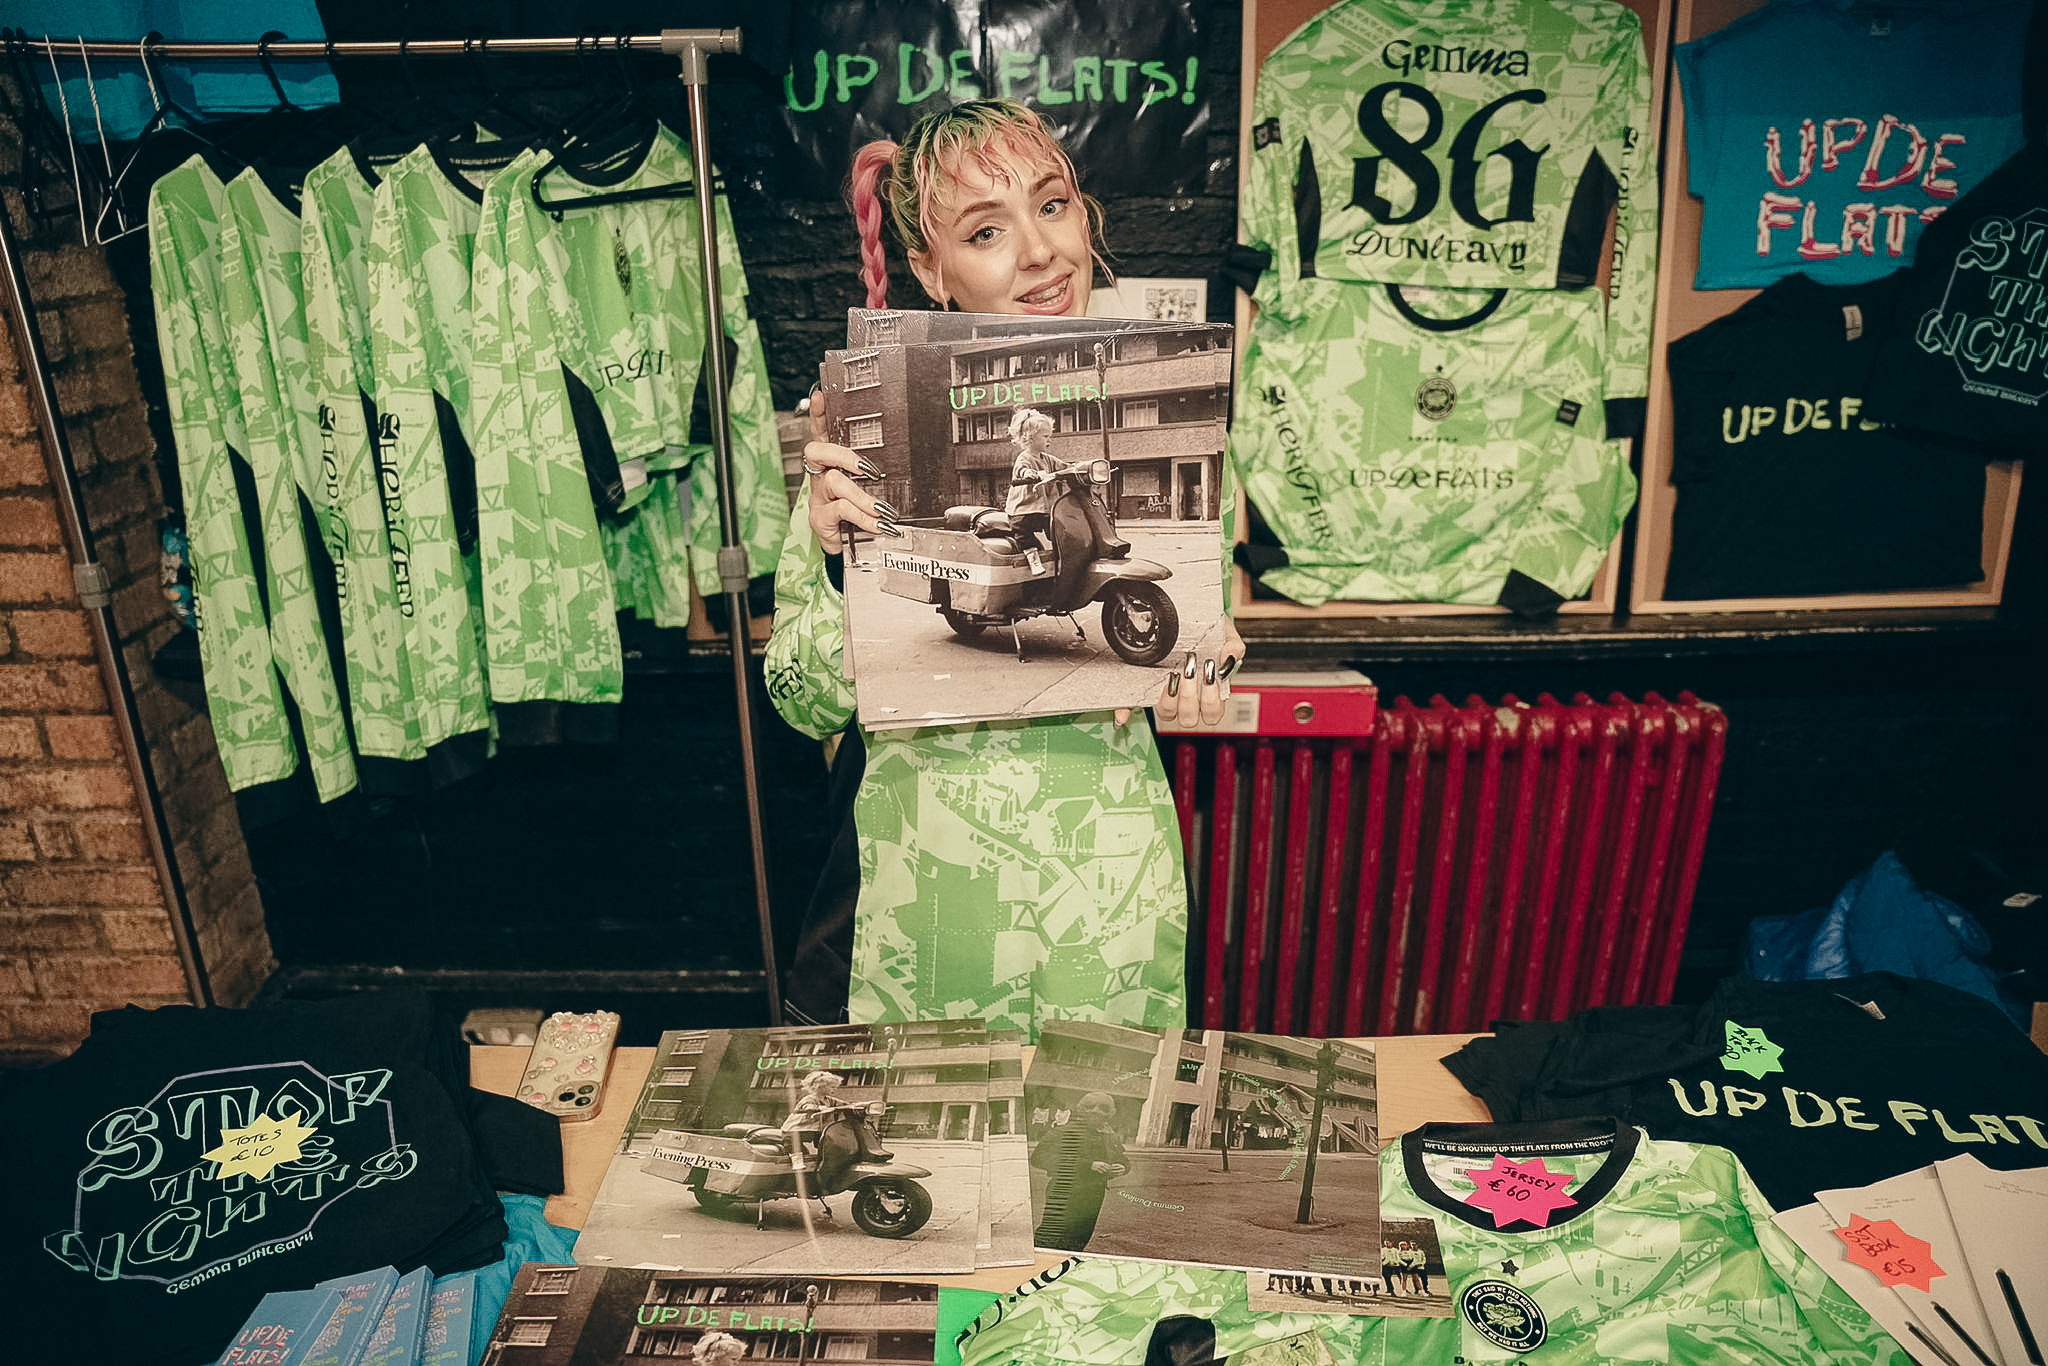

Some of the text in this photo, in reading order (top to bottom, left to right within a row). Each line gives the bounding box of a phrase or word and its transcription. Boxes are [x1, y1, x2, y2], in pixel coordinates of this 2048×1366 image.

[1382, 39, 1529, 77] Gemma
[784, 43, 1199, 112] UP DE FLATS!
[1341, 81, 1551, 231] 86
[1757, 191, 1948, 260] FLAT
[949, 383, 1107, 411] UP DE FLATS!
[1722, 404, 1777, 443] UP
[1783, 397, 1832, 434] DE
[884, 552, 970, 581] Evening Press
[757, 1058, 789, 1070] UP
[794, 1057, 822, 1070] DE
[1668, 1078, 1767, 1117] UP
[1782, 1086, 1880, 1130] DE
[229, 1128, 282, 1146] TOTES
[1457, 1145, 1498, 1153] SHOUTING
[1499, 1145, 1509, 1153] UP
[1551, 1142, 1574, 1150] FROM
[1574, 1141, 1589, 1149] THE
[652, 1147, 733, 1171] Evening Press
[1501, 1166, 1556, 1191] JERSEY
[637, 1304, 815, 1333] UP DE FLATS!
